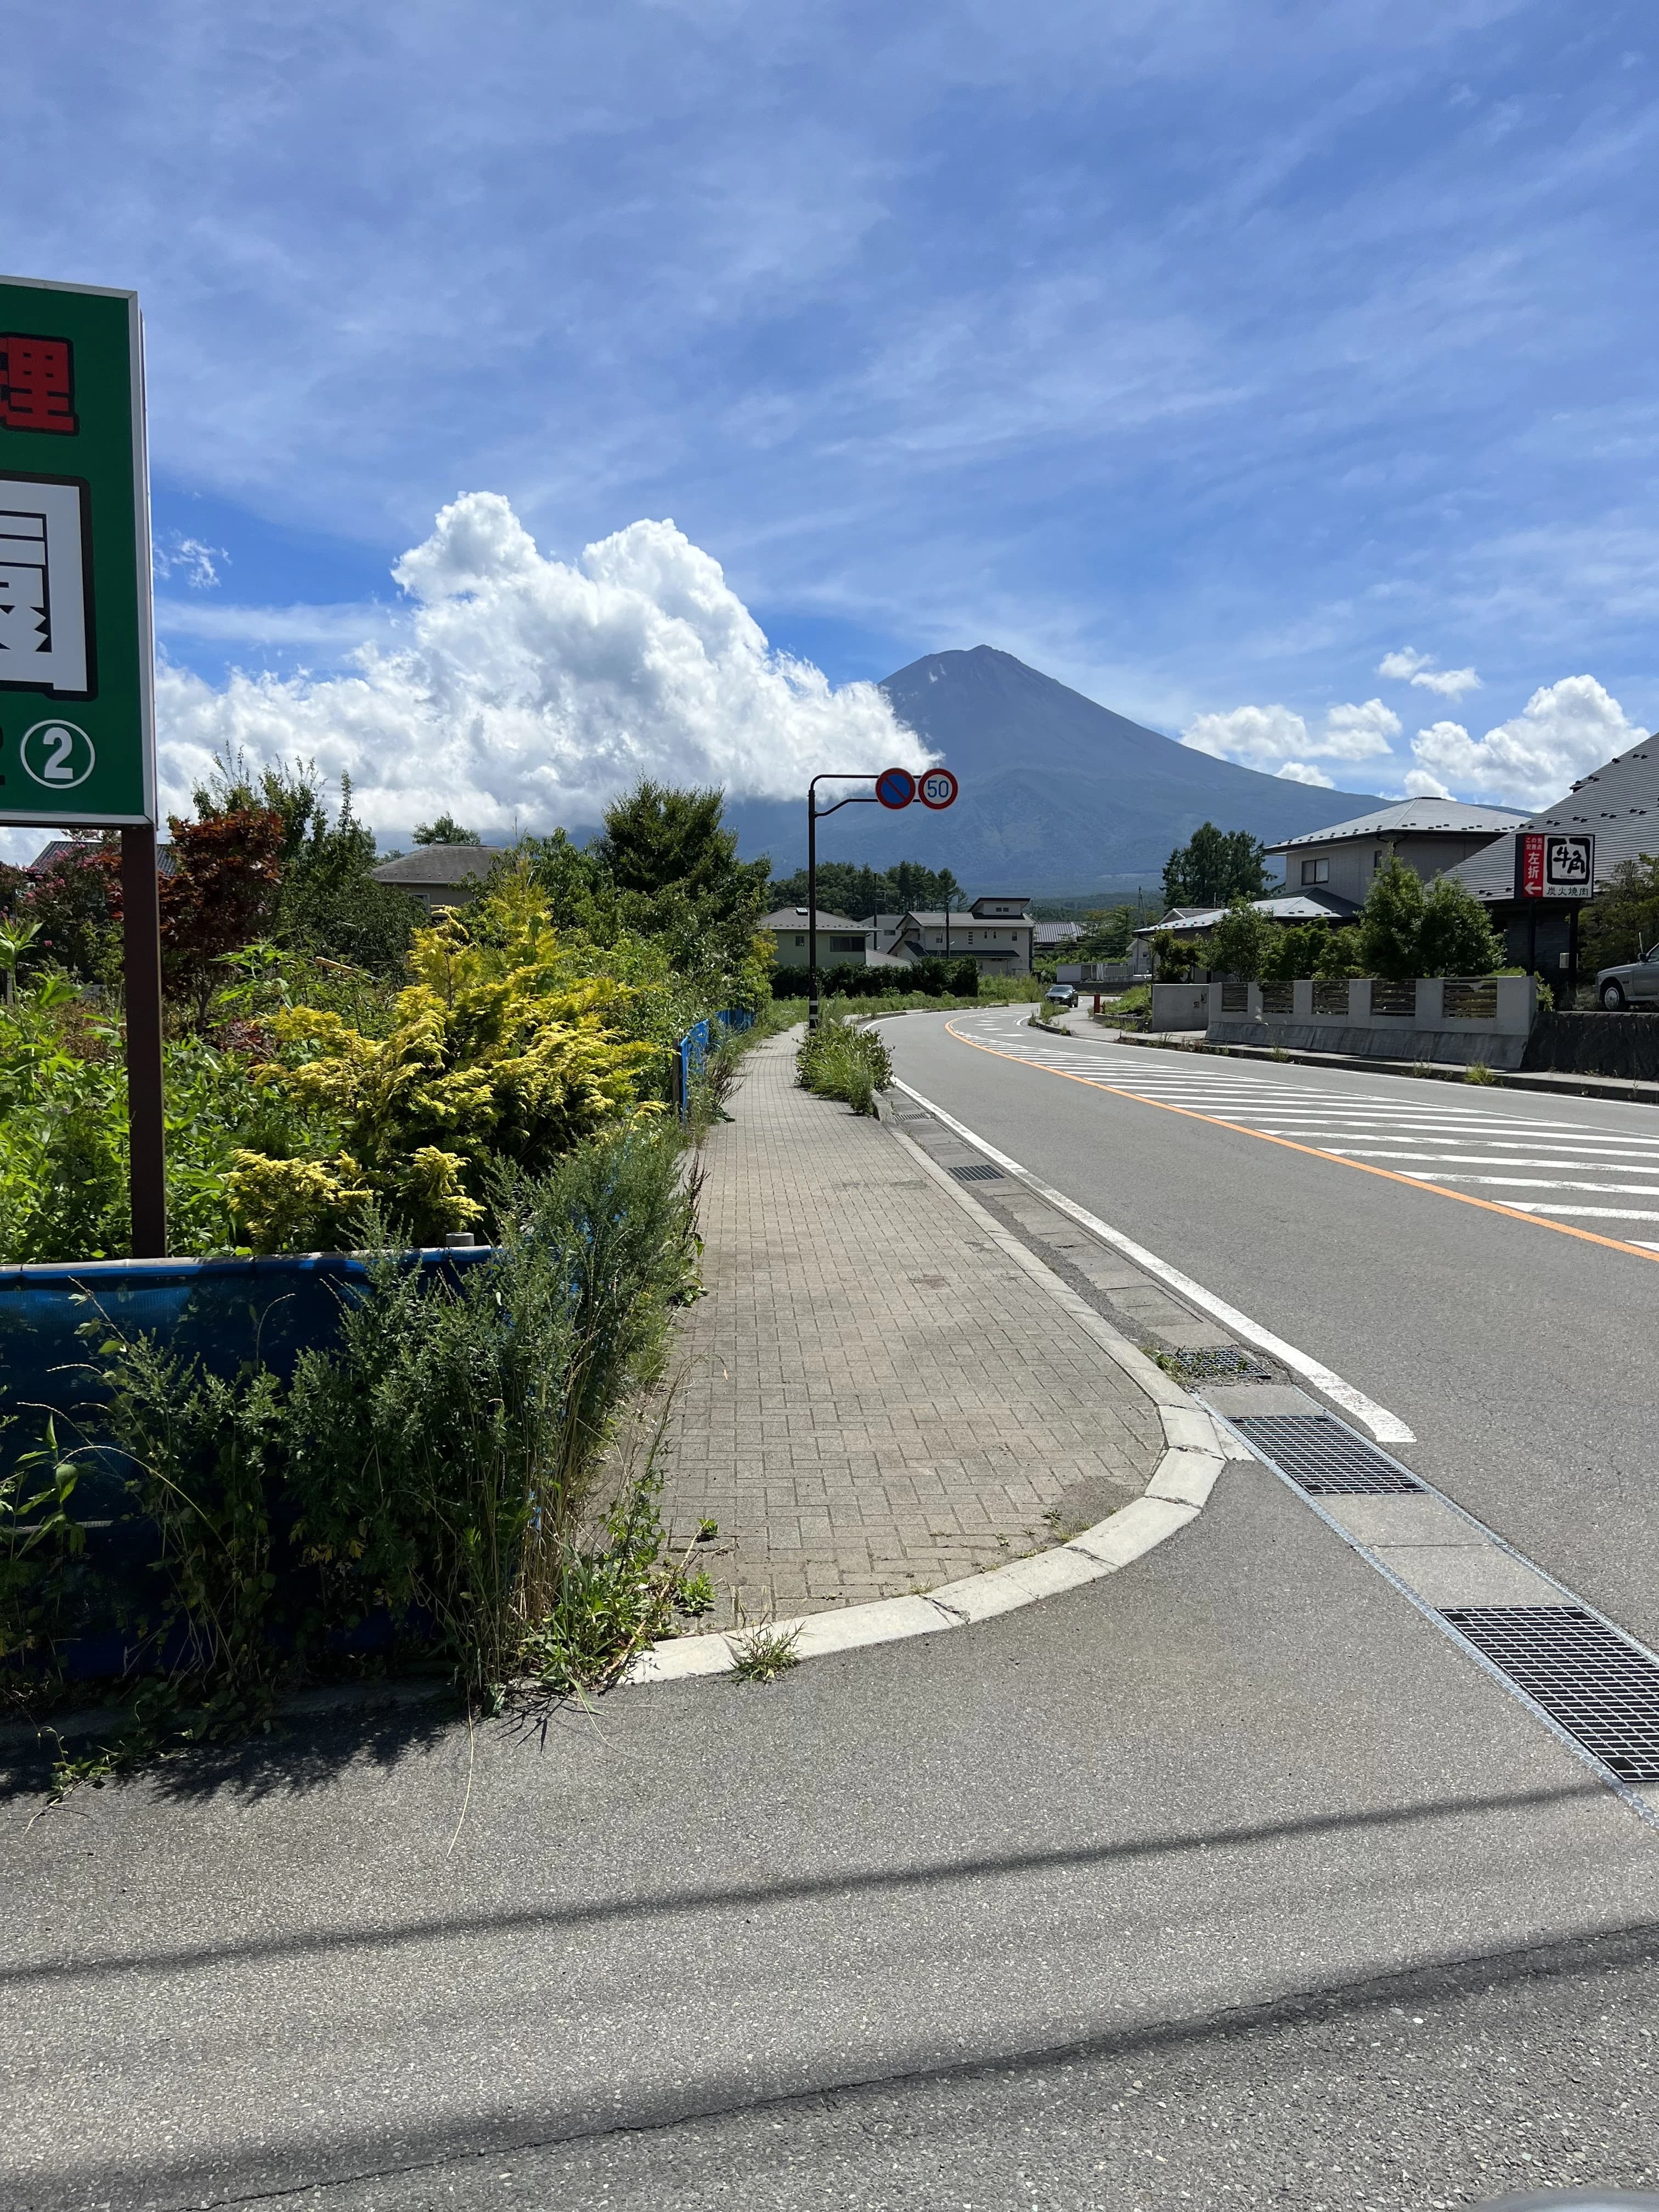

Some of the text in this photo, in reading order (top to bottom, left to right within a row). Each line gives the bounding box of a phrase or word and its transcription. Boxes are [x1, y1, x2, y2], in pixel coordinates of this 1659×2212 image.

[927, 780, 949, 798] 50
[1527, 851, 1540, 879] 左折
[1553, 846, 1585, 874] 牛角
